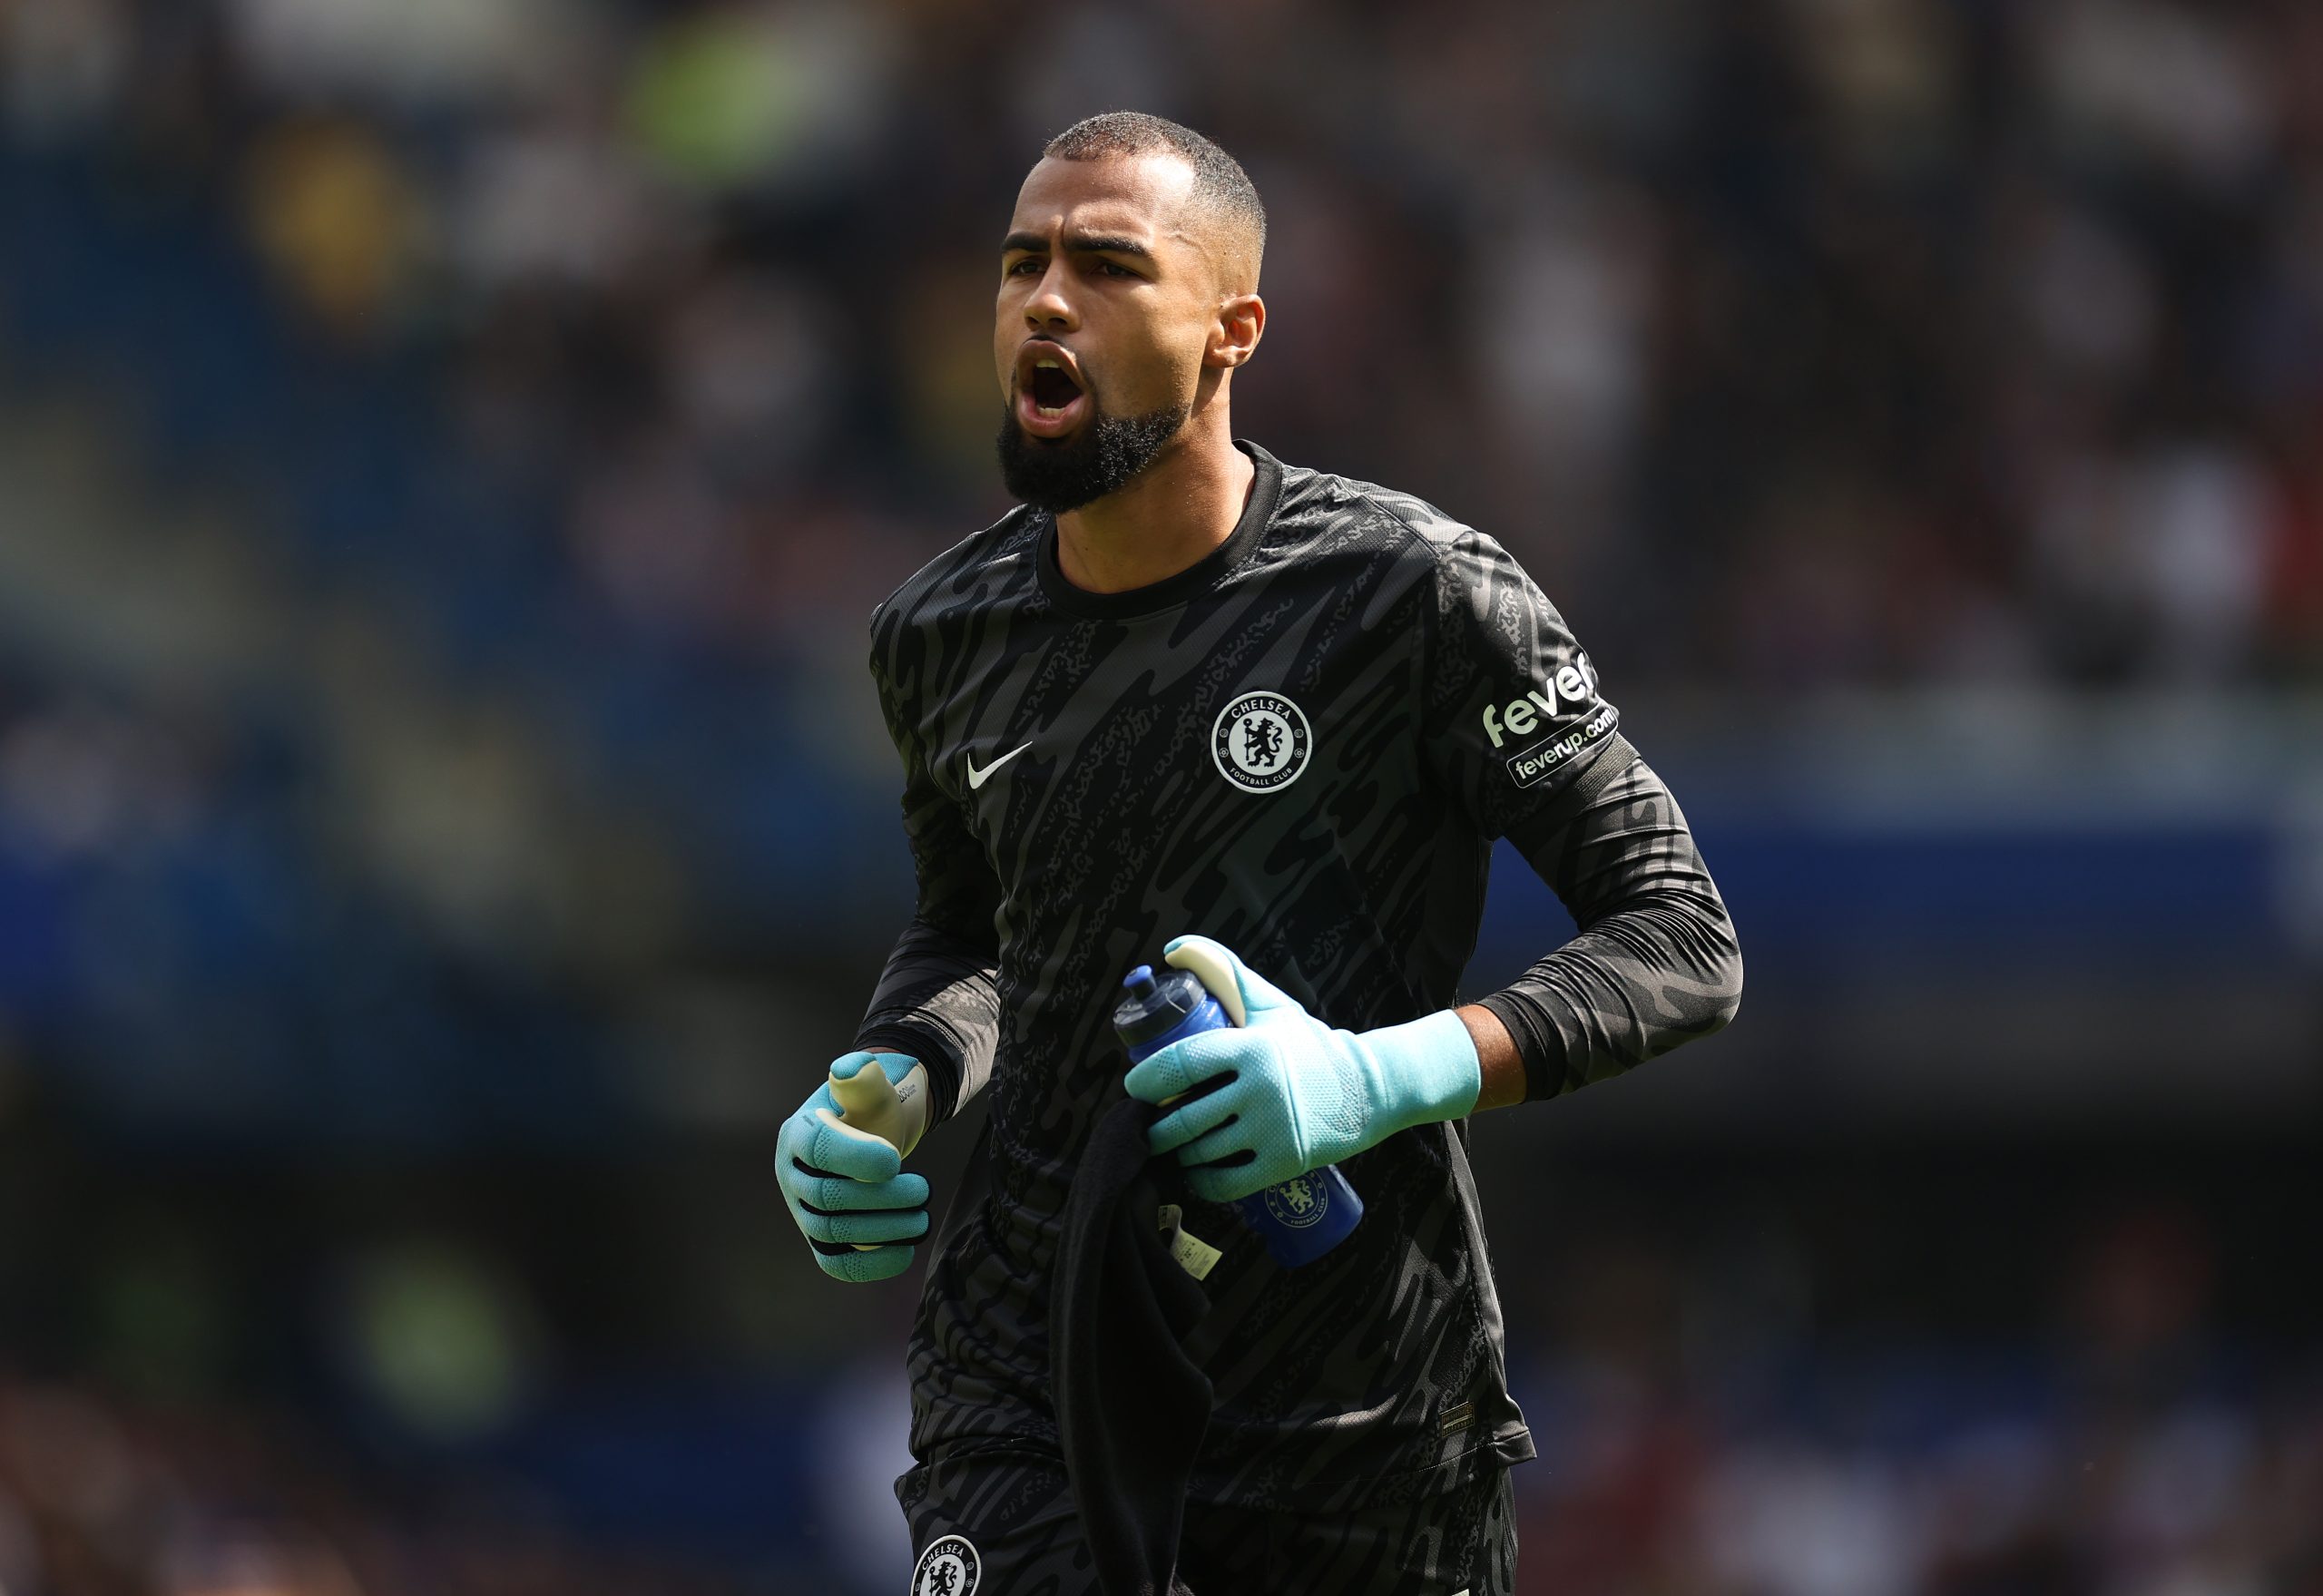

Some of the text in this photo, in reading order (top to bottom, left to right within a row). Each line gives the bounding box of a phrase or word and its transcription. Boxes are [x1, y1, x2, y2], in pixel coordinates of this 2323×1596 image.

[1231, 699, 1291, 720] CHELSEA
[1482, 652, 1594, 749] fever
[1514, 709, 1615, 780] feverup.com
[1230, 768, 1293, 786] FOOTBALL CLUB
[922, 1543, 965, 1571] CHELSEA
